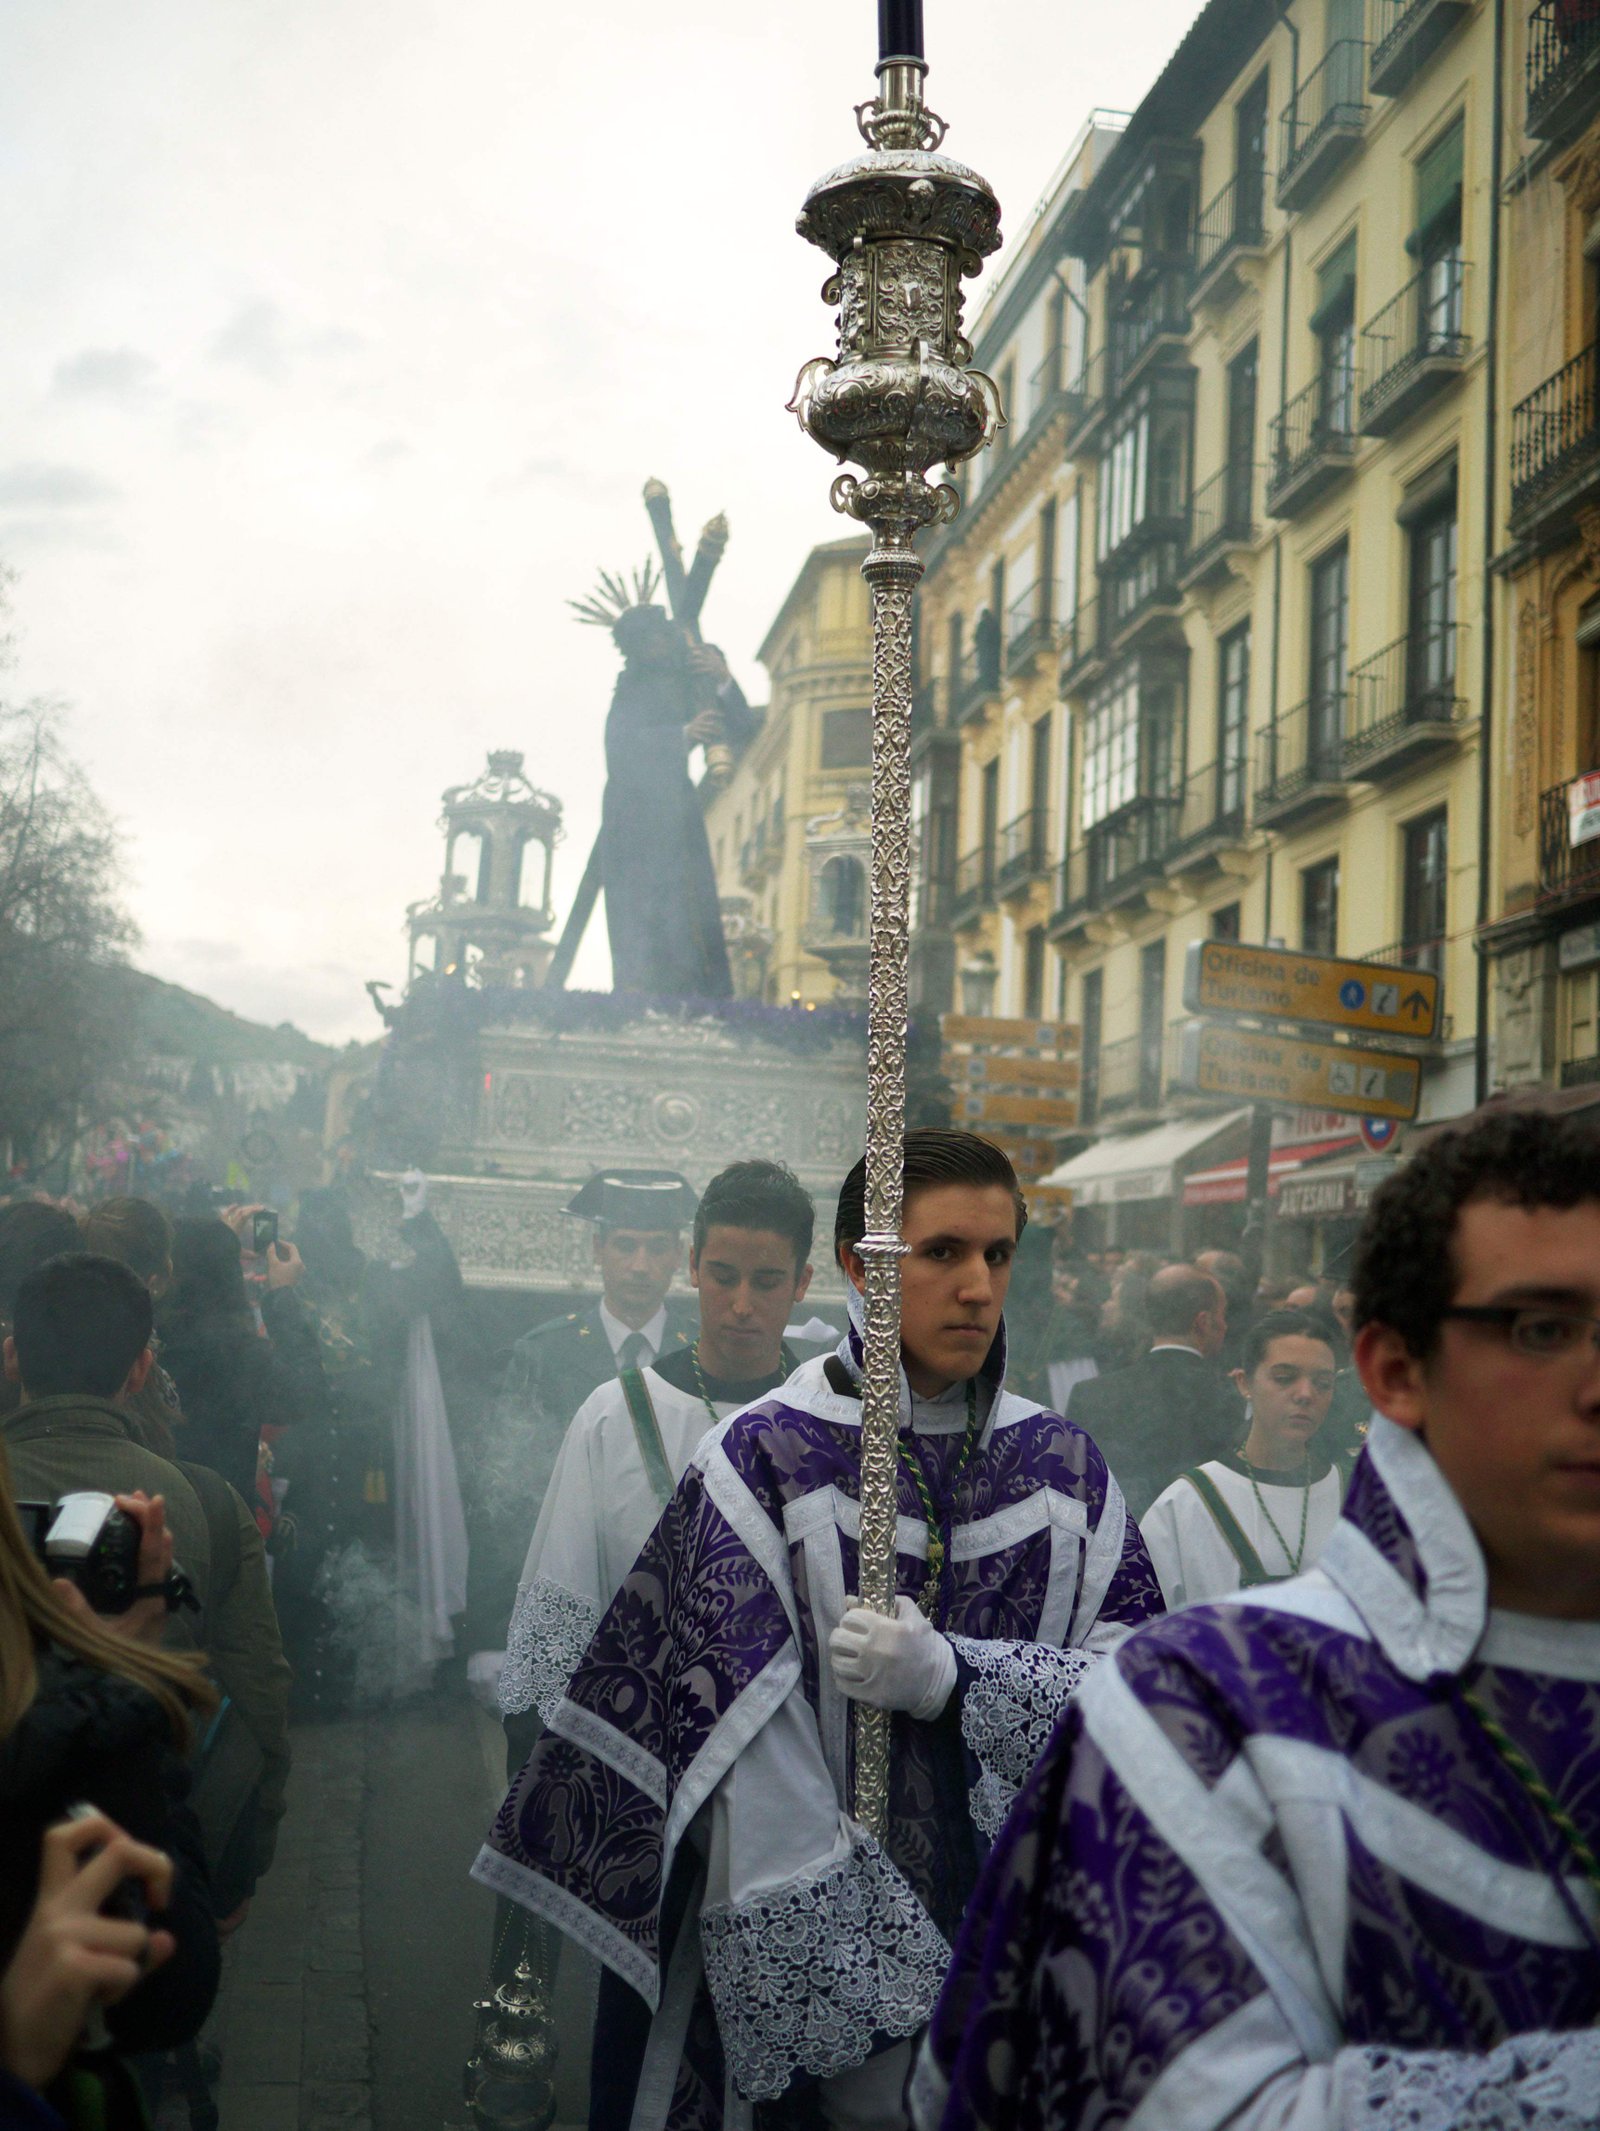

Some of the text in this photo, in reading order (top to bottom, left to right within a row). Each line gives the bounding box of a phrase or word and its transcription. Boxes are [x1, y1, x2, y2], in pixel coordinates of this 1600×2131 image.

[1206, 951, 1321, 986] Oficina de
[1206, 976, 1292, 1007] Turismo
[1297, 1052, 1322, 1072] de
